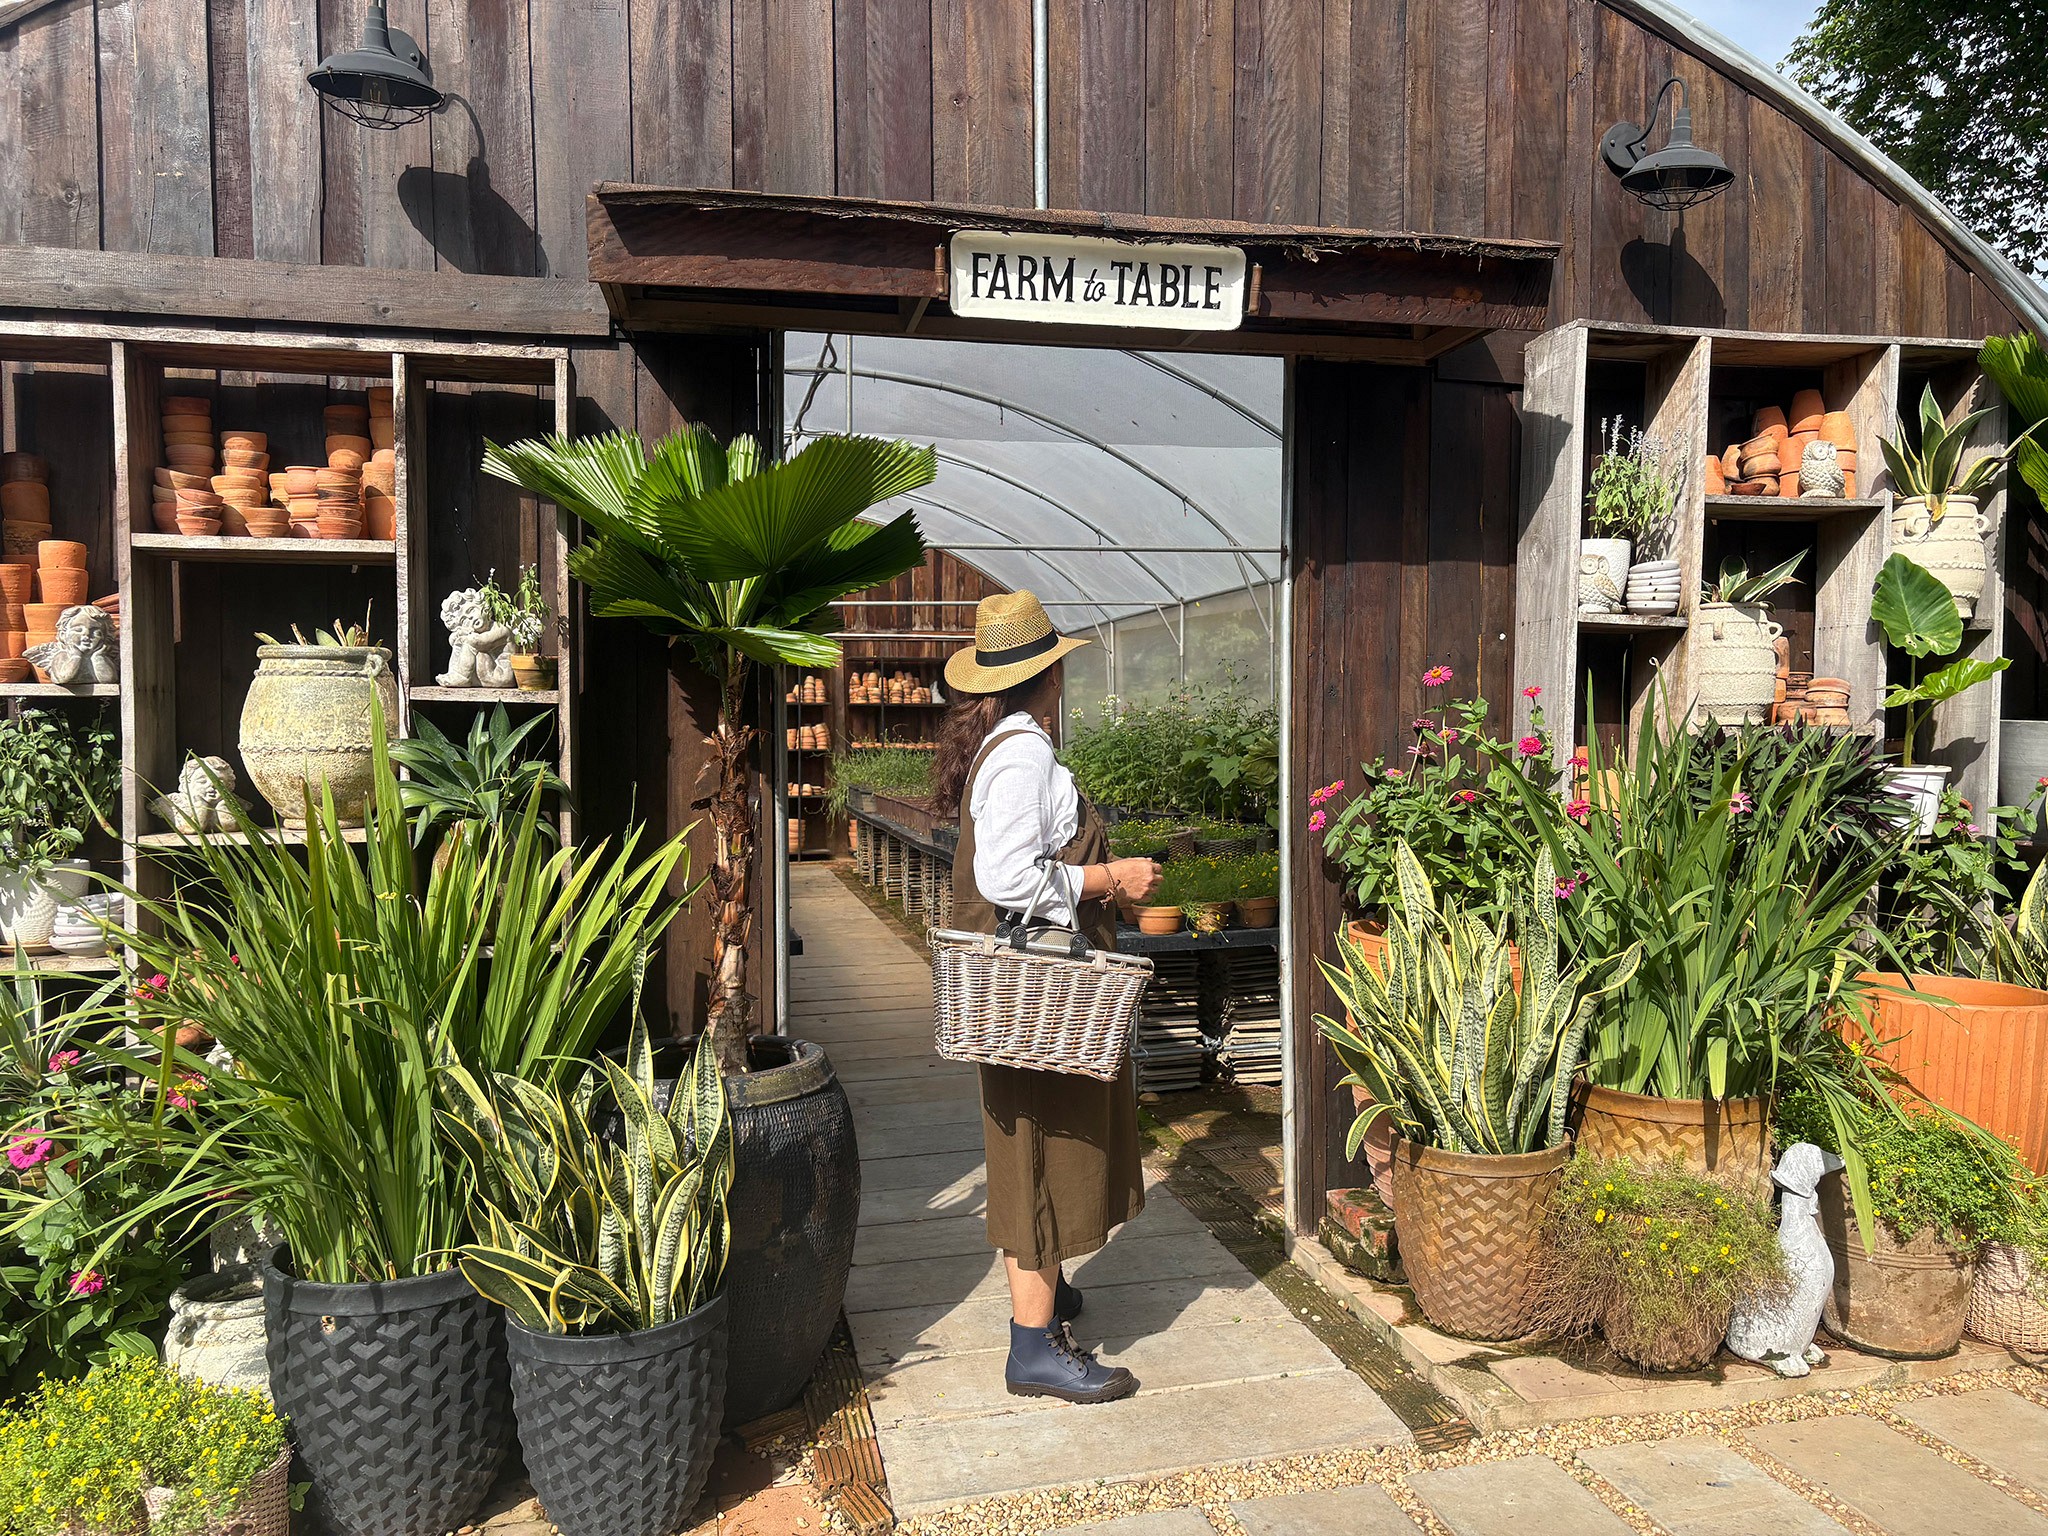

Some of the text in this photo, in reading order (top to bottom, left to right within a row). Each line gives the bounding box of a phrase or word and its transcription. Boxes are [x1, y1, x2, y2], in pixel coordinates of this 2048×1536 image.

[971, 252, 1223, 310] FARM to TABLE
